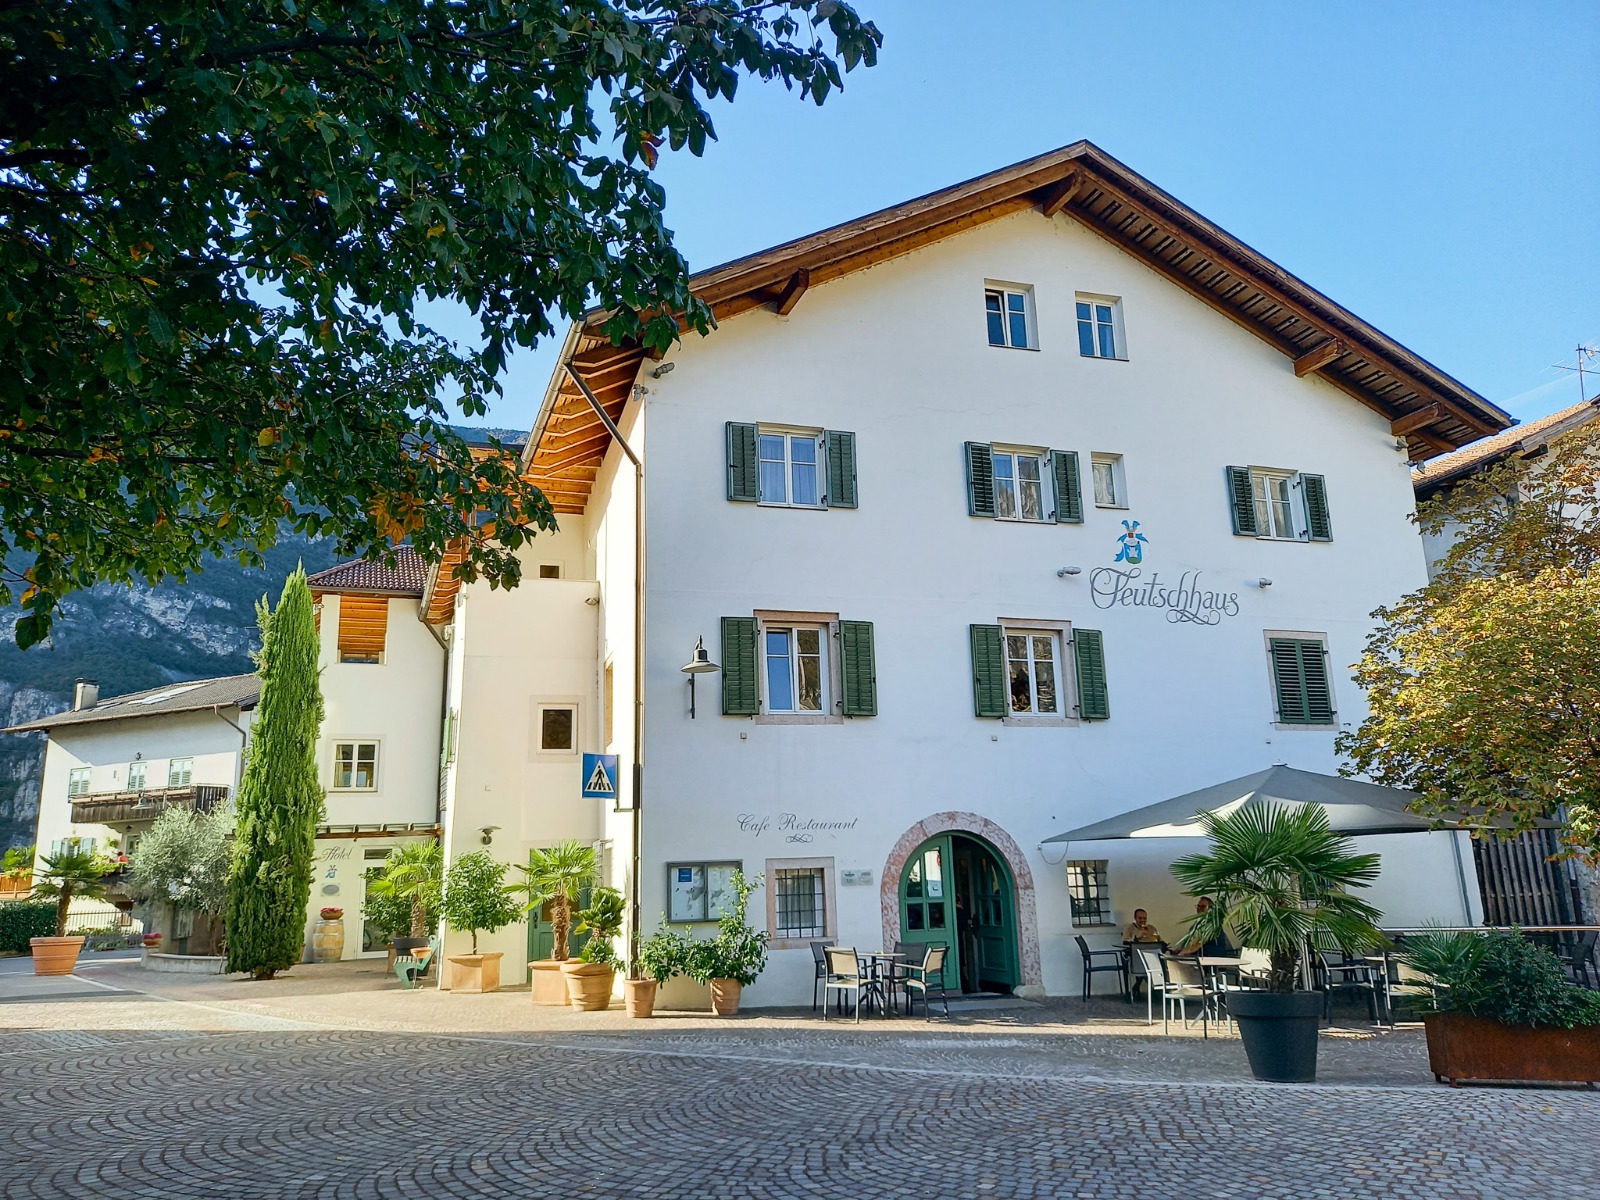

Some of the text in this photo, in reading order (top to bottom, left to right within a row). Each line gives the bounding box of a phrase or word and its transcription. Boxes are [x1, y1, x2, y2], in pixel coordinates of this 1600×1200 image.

[1089, 566, 1240, 626] Teutschhaus
[778, 812, 858, 831] Restaurant
[320, 846, 355, 862] Hotel
